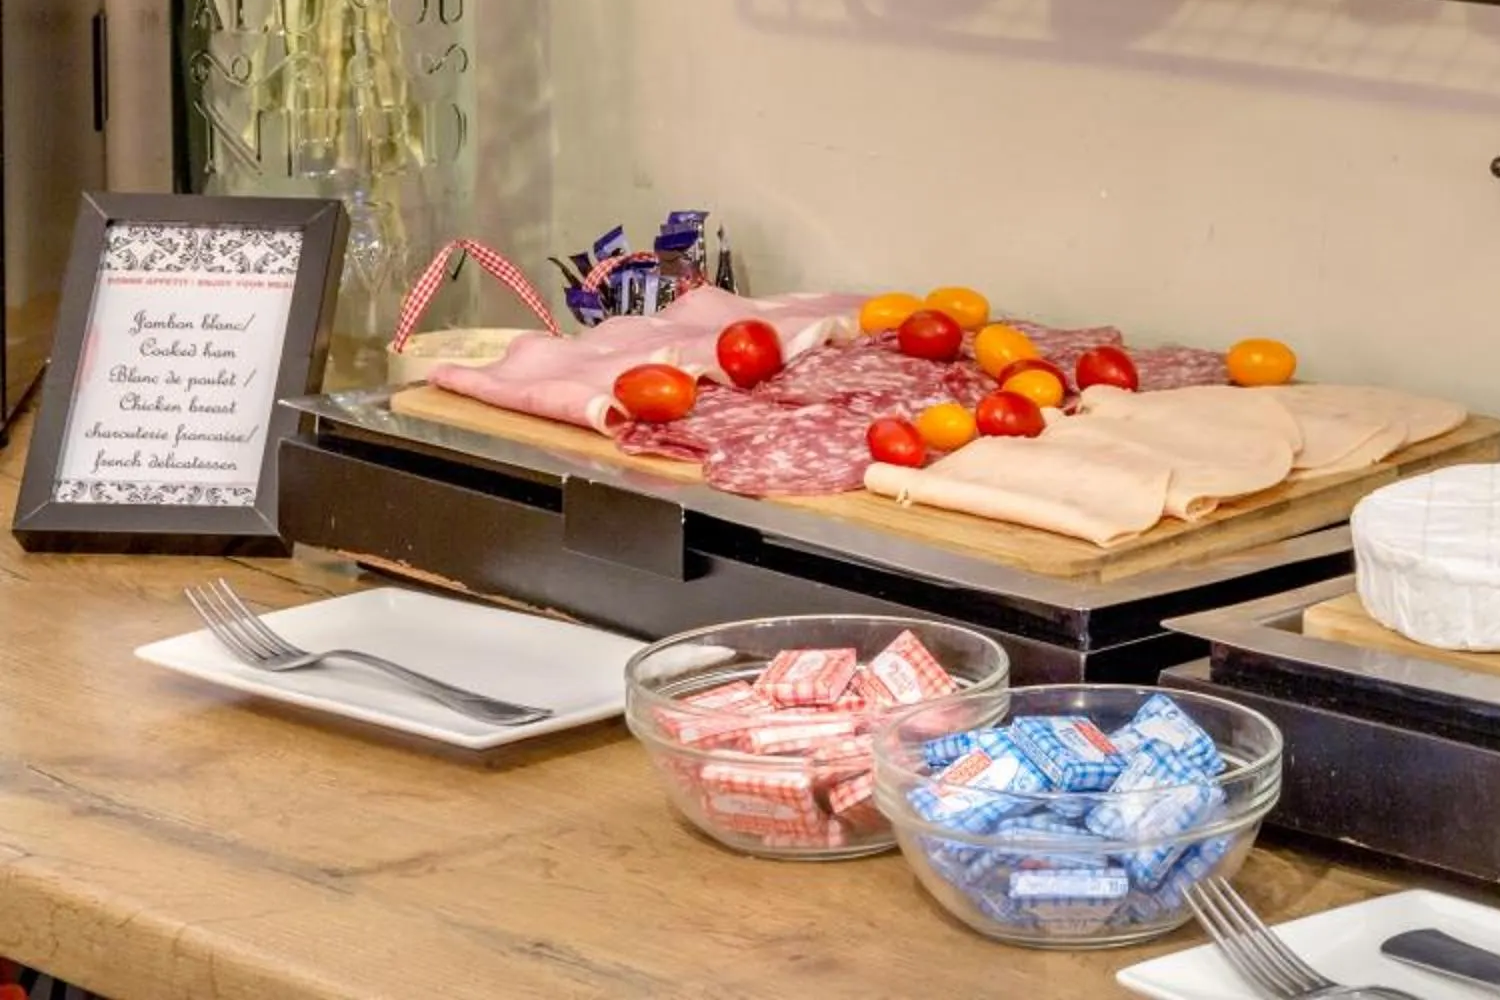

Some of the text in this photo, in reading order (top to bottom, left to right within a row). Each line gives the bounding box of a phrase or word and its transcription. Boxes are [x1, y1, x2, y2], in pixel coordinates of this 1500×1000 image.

[128, 309, 194, 336] Jambon
[139, 337, 236, 358] Cooked ham
[109, 364, 158, 385] Blanc
[165, 370, 181, 385] de
[184, 369, 237, 392] poulet
[119, 392, 237, 414] Chicken breast
[85, 422, 169, 440] charcuterie
[91, 448, 238, 474] french delicatessen
